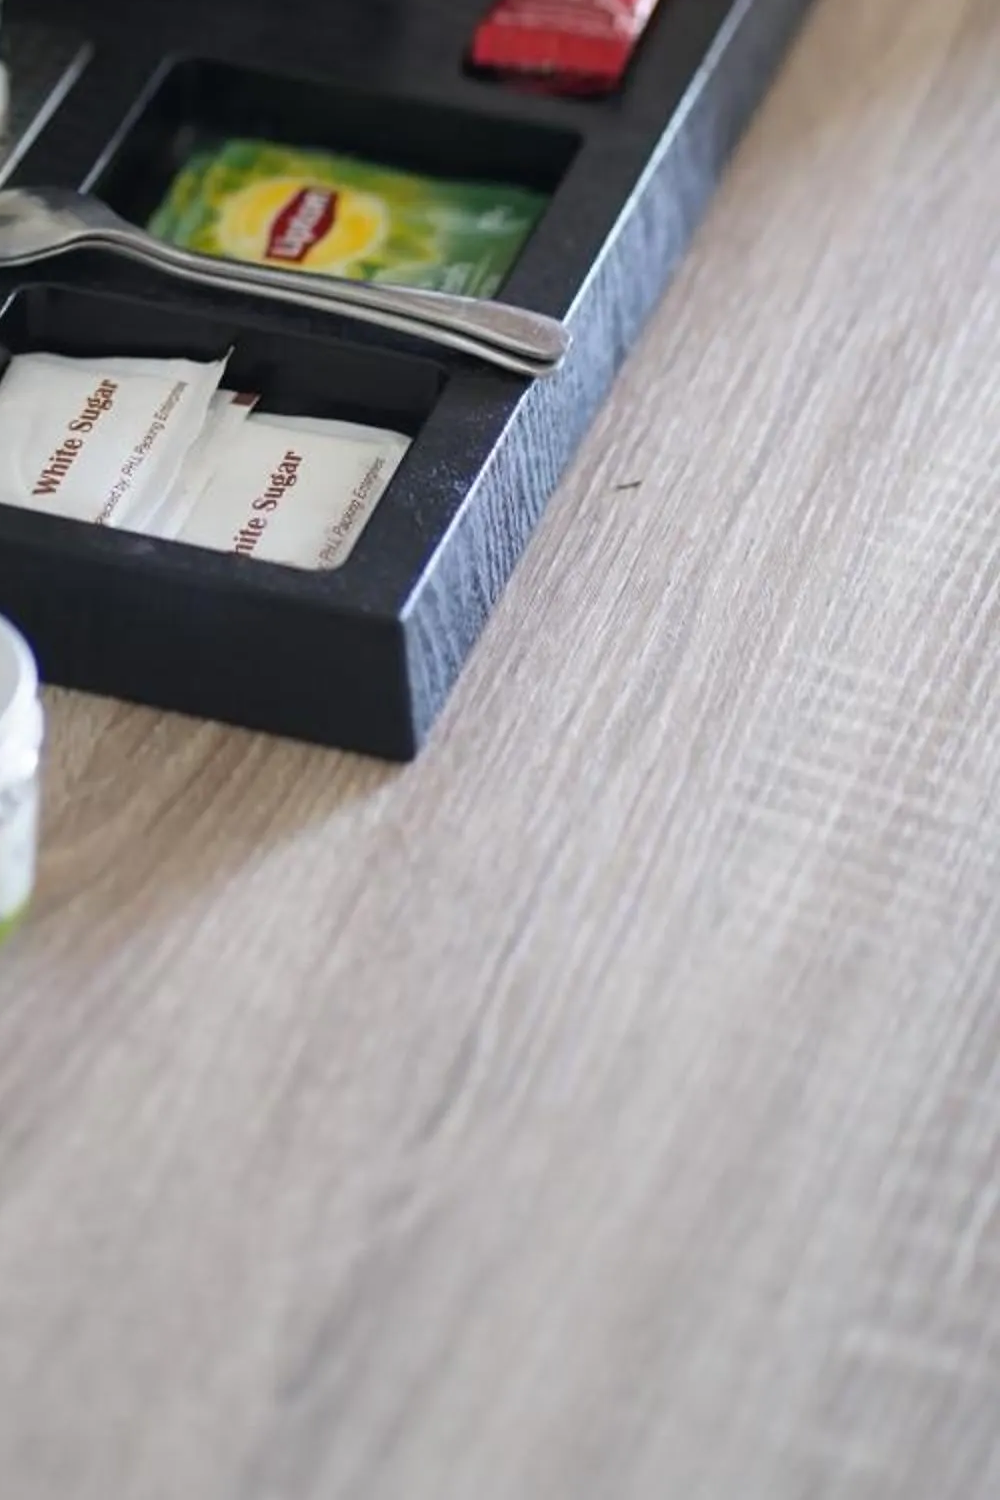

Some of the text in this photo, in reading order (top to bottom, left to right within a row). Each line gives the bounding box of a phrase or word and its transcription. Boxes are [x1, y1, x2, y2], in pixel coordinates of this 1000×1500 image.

[31, 379, 118, 495] White Sugar
[234, 450, 303, 556] hite Sugar
